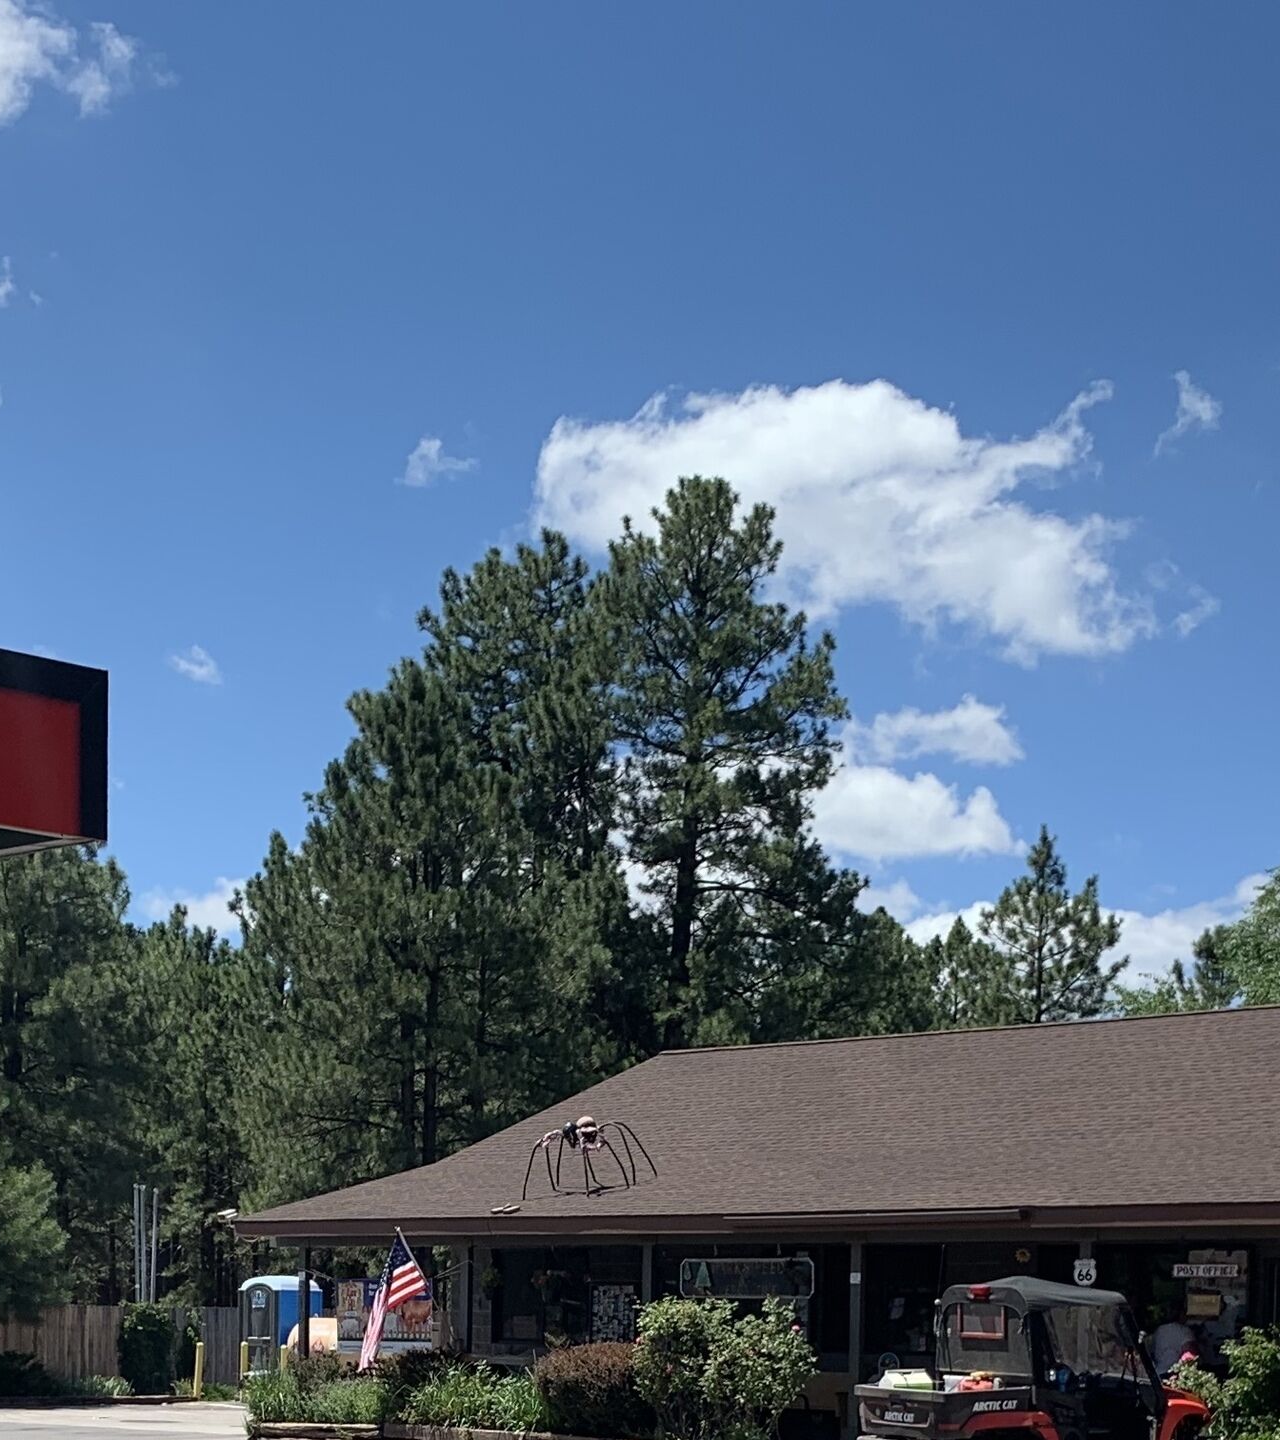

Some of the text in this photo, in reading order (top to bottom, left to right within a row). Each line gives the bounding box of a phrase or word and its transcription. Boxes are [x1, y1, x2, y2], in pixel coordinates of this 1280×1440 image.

[1077, 1268, 1093, 1282] 66
[1175, 1265, 1237, 1277] POST OFFICE
[972, 1400, 1018, 1412] ARCTIC CAT
[884, 1411, 914, 1422] ARCTIC CAT
